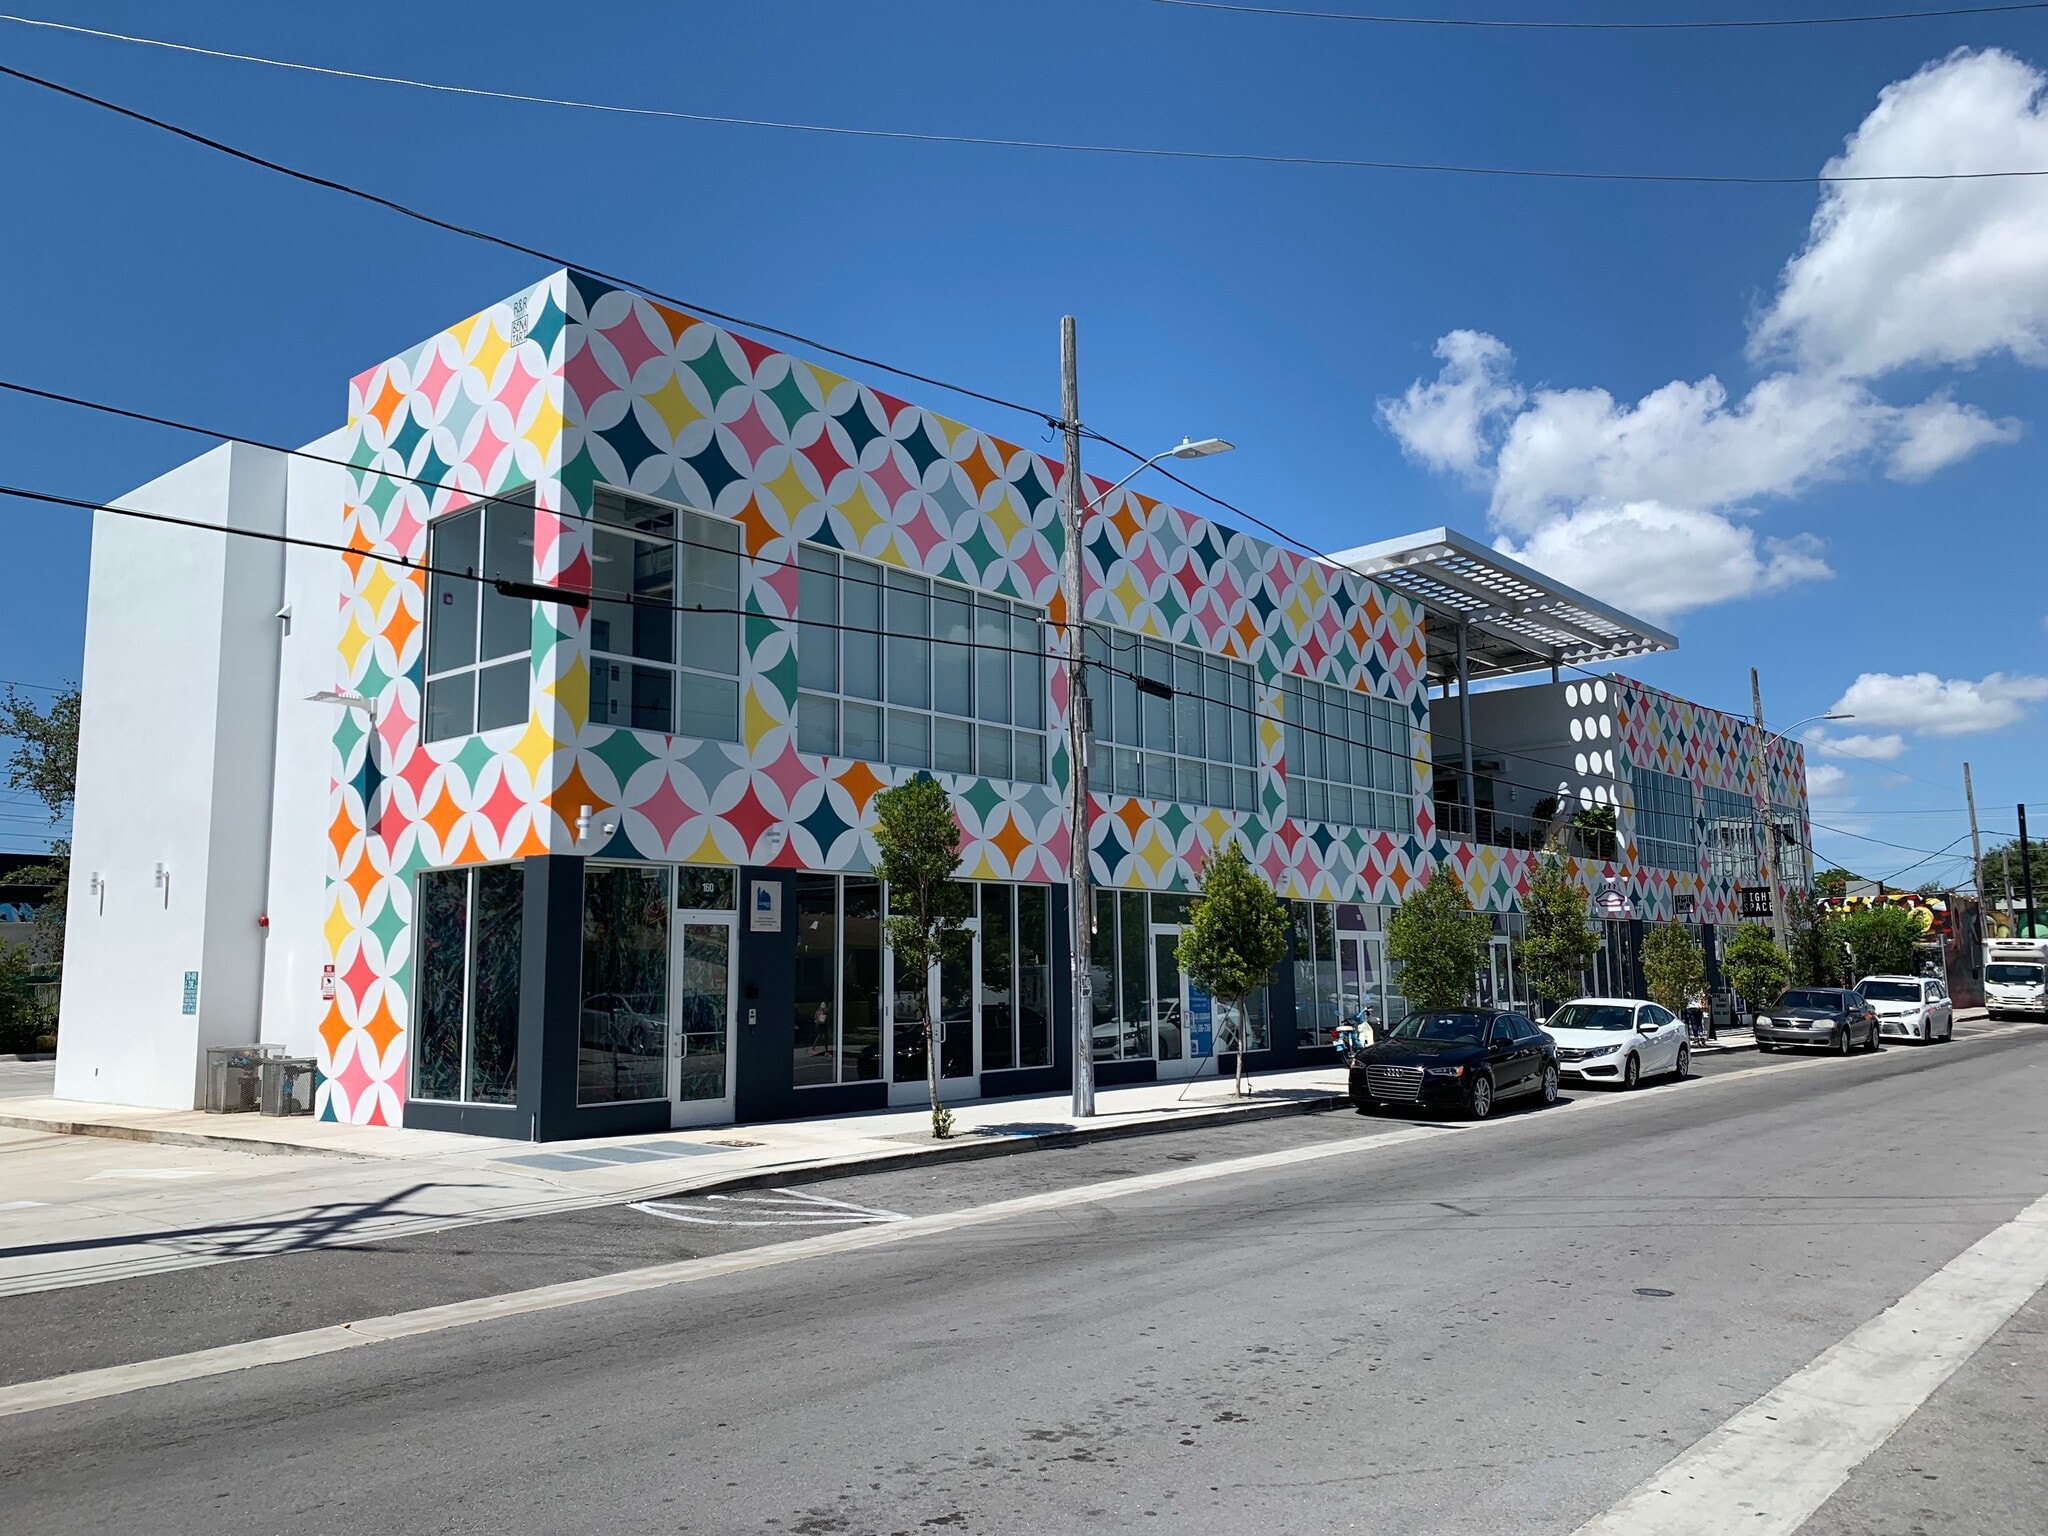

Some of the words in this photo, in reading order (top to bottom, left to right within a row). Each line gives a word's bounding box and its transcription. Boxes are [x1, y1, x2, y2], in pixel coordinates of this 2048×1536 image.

[513, 296, 528, 315] R&R
[702, 882, 715, 892] 160
[1743, 902, 1773, 912] SPACE
